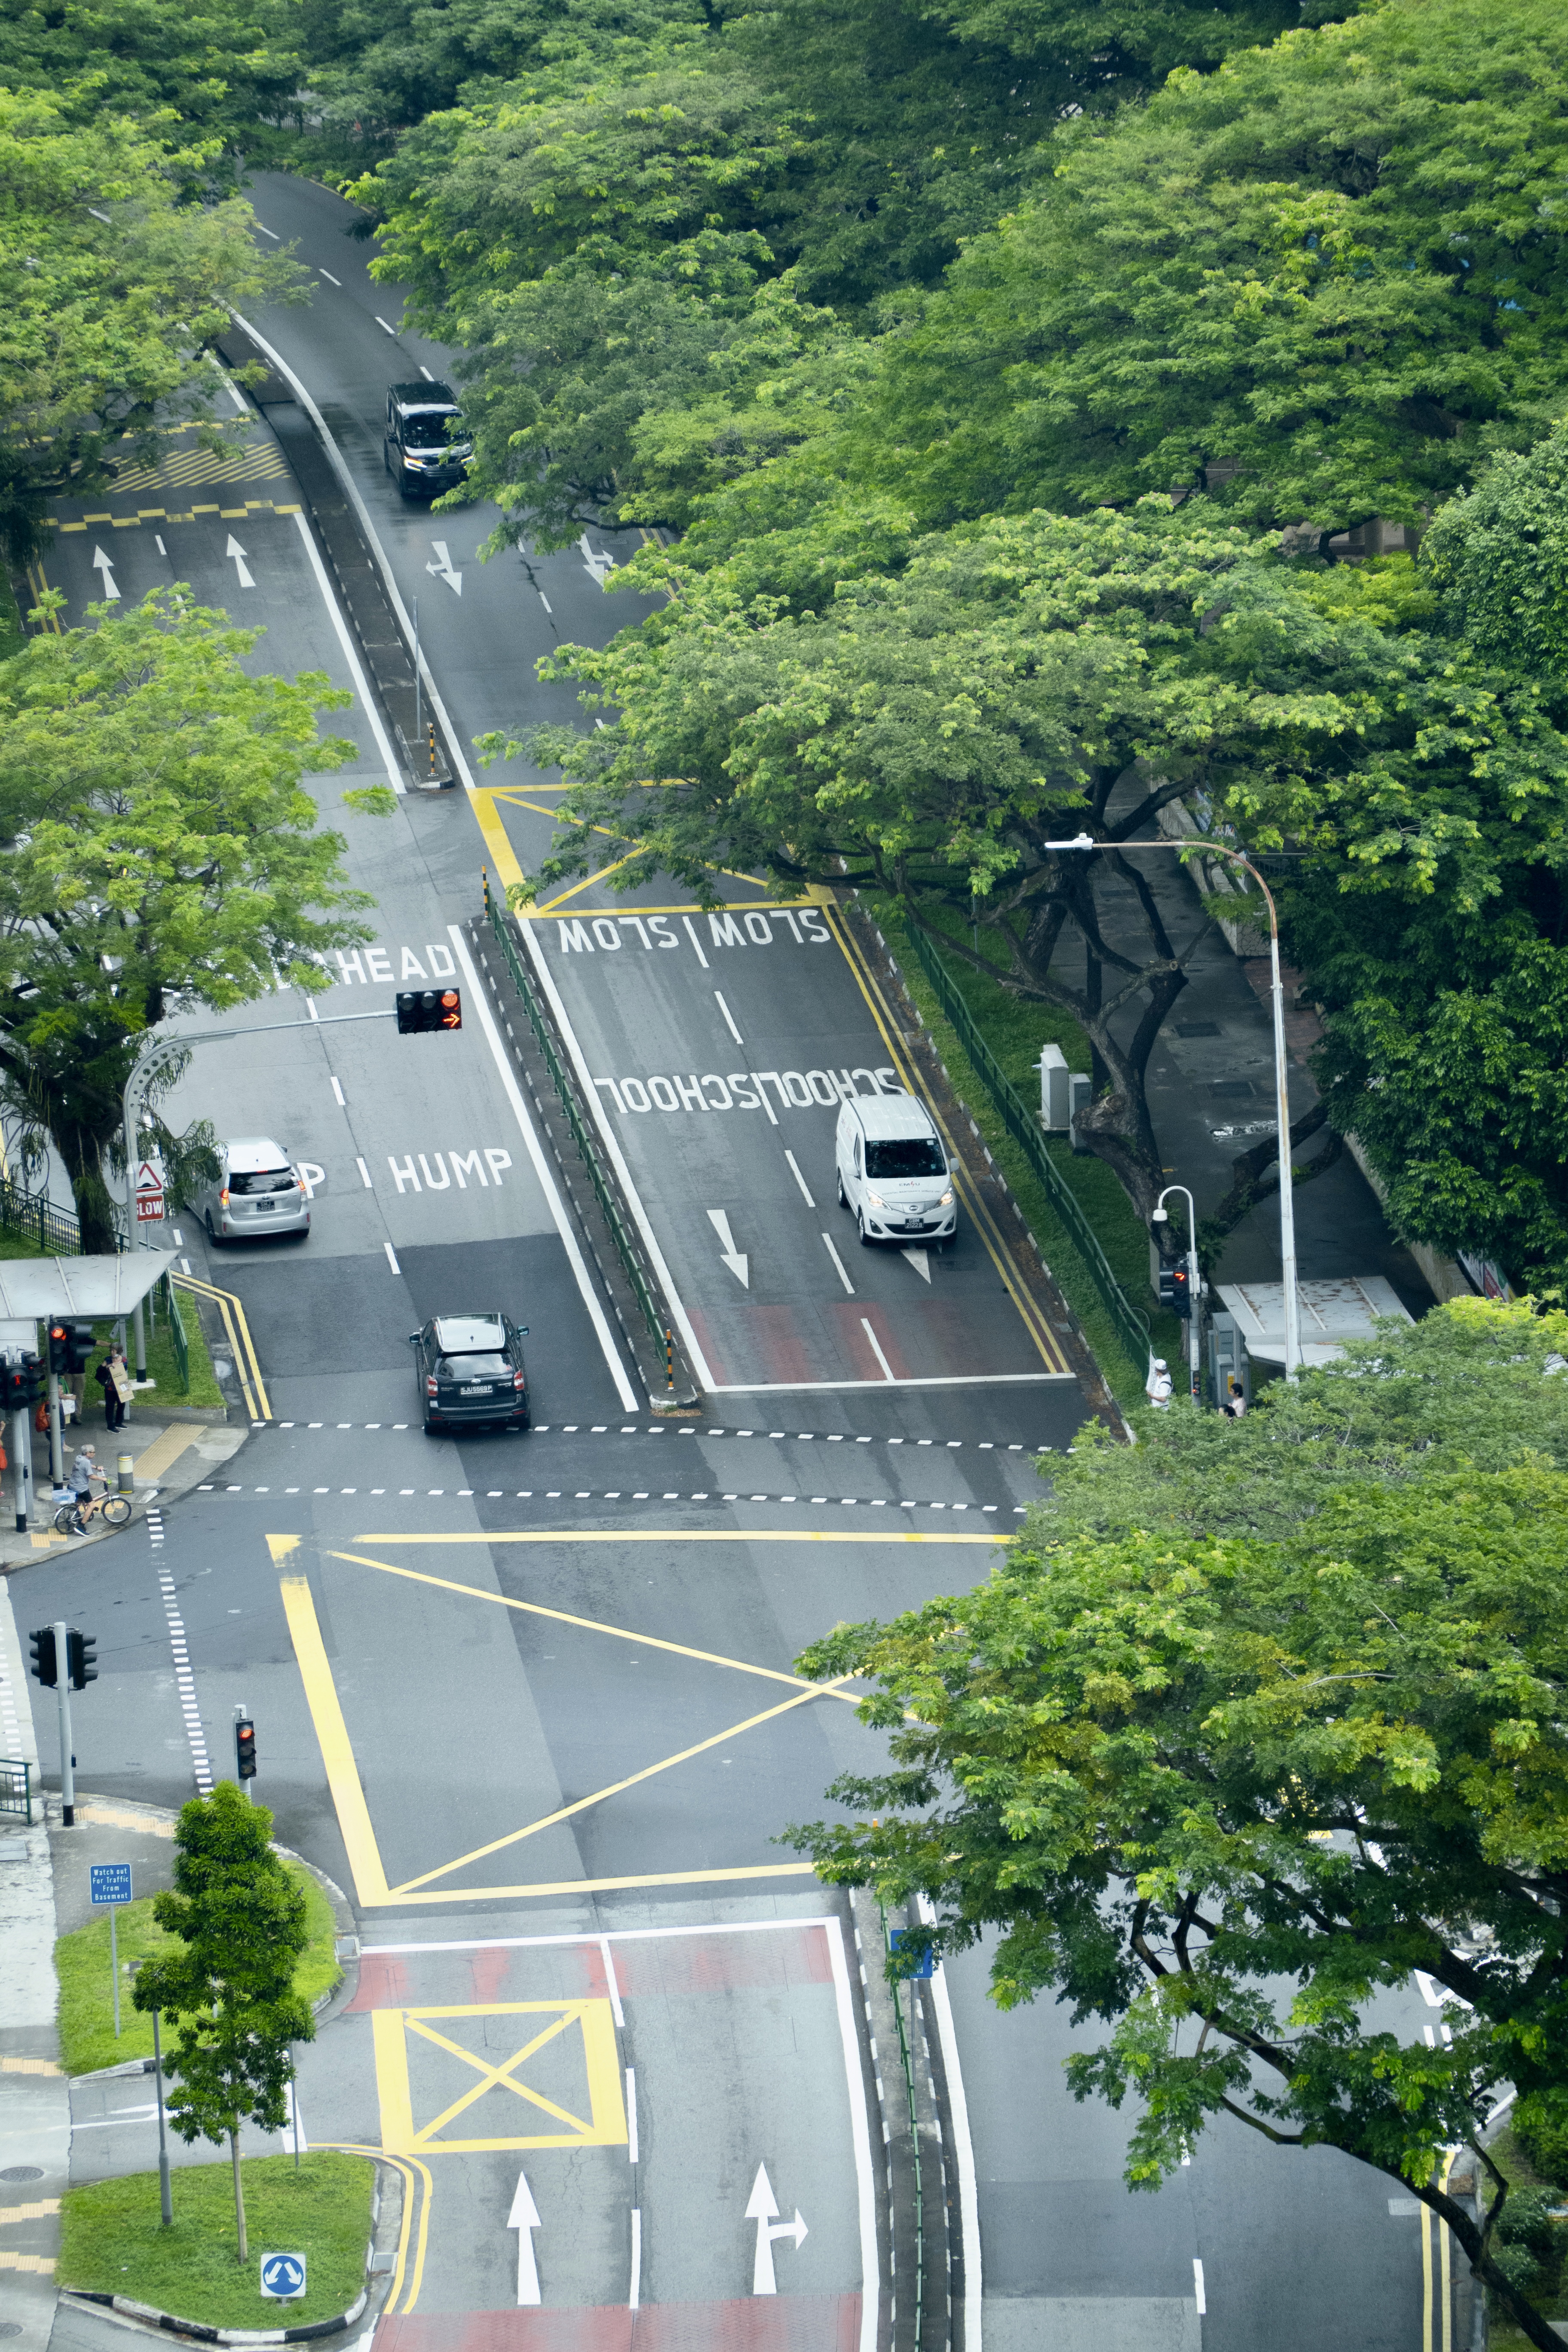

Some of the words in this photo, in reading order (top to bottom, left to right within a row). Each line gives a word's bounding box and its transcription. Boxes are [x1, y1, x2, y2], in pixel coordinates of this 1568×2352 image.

[557, 916, 679, 952] SLOW
[708, 909, 831, 946] SLOW
[593, 1073, 762, 1113] SCHOOL
[758, 1067, 909, 1108] SCHOOL
[388, 1148, 512, 1193] HUMP
[95, 1892, 128, 1901] Basement
